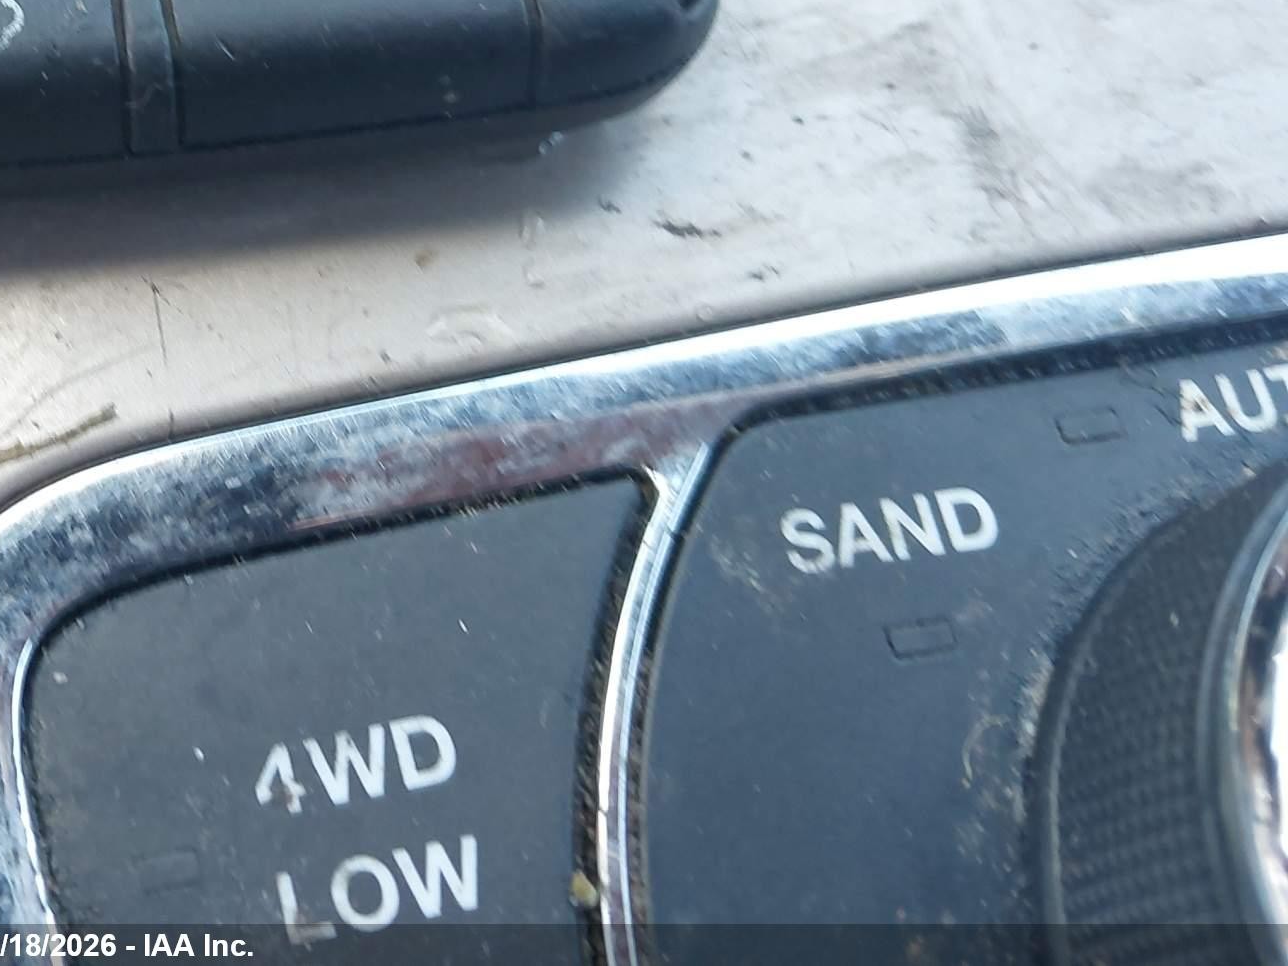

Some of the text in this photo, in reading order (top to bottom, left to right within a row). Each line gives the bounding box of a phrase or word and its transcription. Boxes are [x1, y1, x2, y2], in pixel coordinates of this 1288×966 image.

[780, 487, 999, 574] SAND
[255, 714, 457, 814] 4WD
[276, 835, 478, 945] LOW
